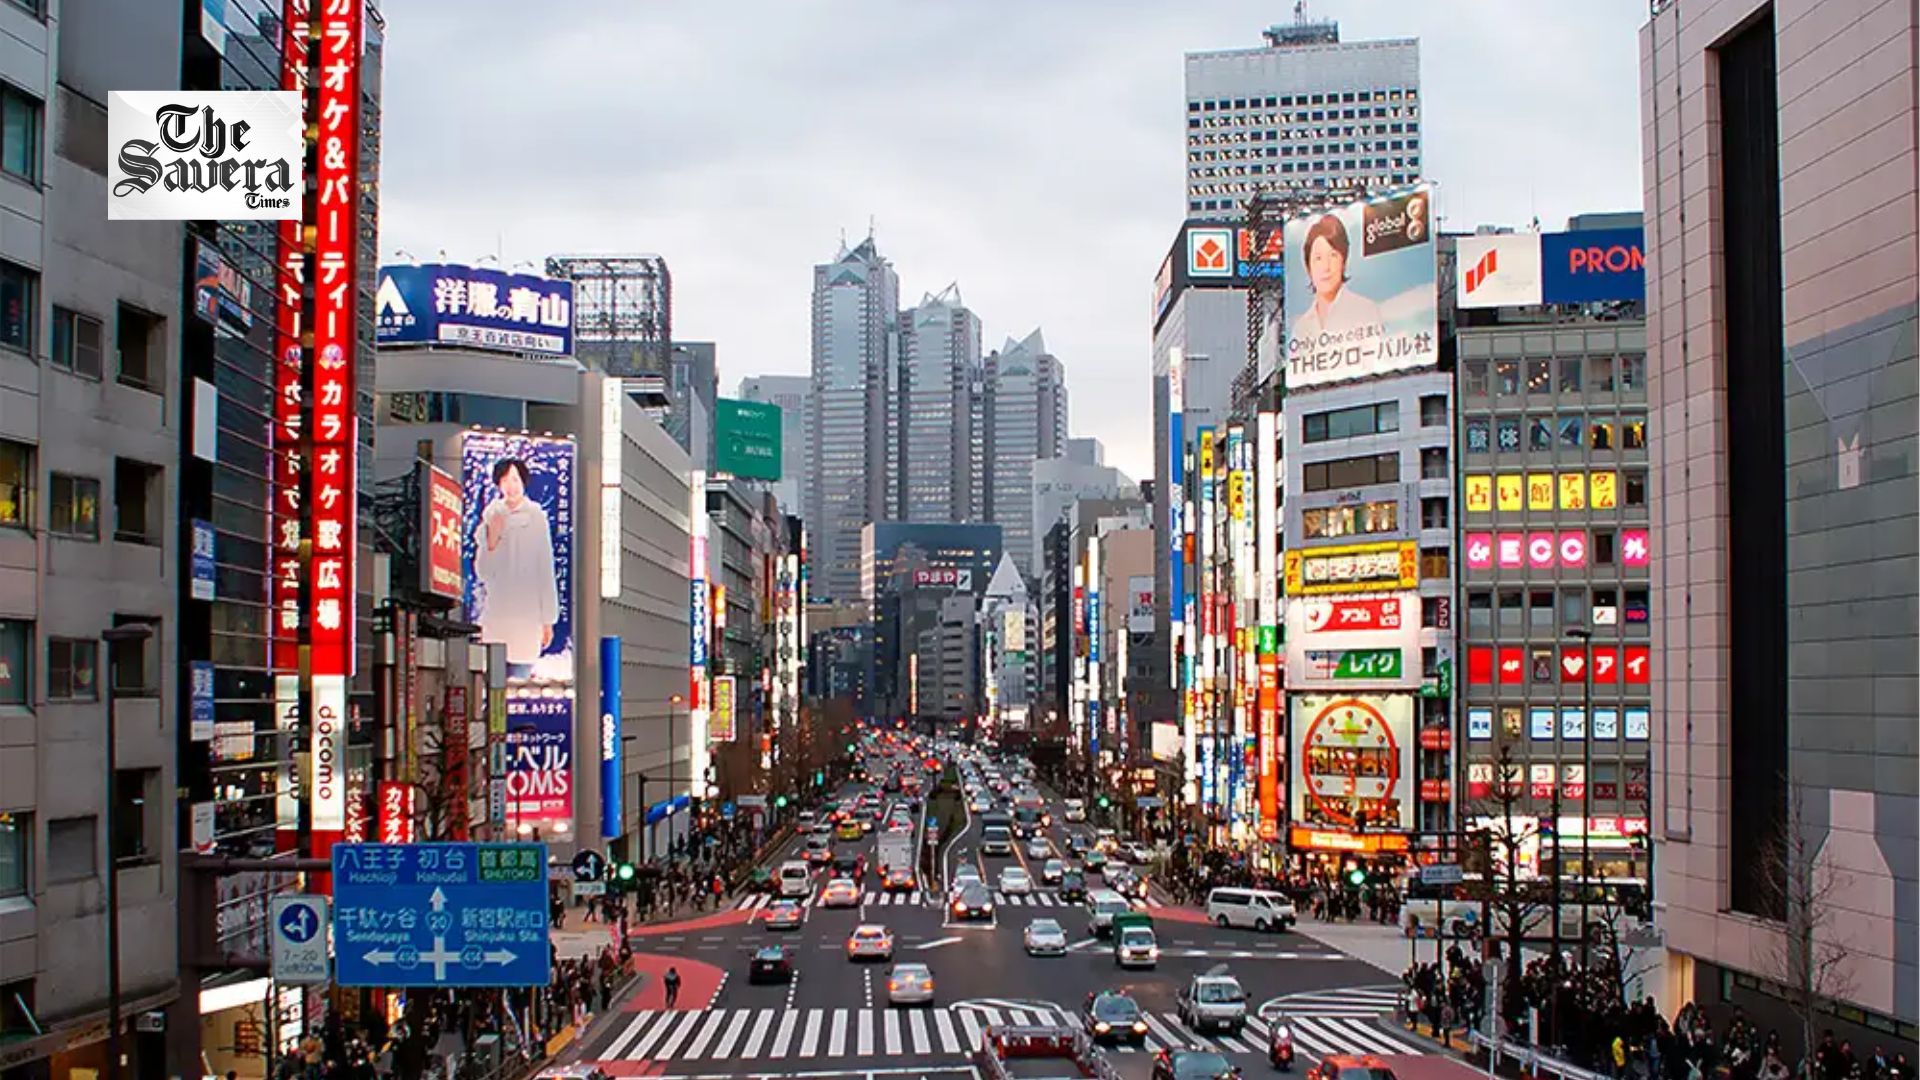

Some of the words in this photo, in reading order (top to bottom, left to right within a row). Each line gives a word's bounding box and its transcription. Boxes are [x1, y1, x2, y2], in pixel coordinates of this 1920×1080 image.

[434, 277, 569, 328] 洋服の青山
[1290, 332, 1432, 375] THEグローバル社
[1500, 538, 1583, 563] ECC
[1340, 608, 1371, 624] アコム
[1350, 654, 1394, 674] レイク
[319, 705, 337, 799] docomo
[340, 848, 406, 869] 八王子
[418, 848, 467, 869] 初台
[430, 915, 447, 929] 20
[461, 908, 543, 929] 新宿駅西口
